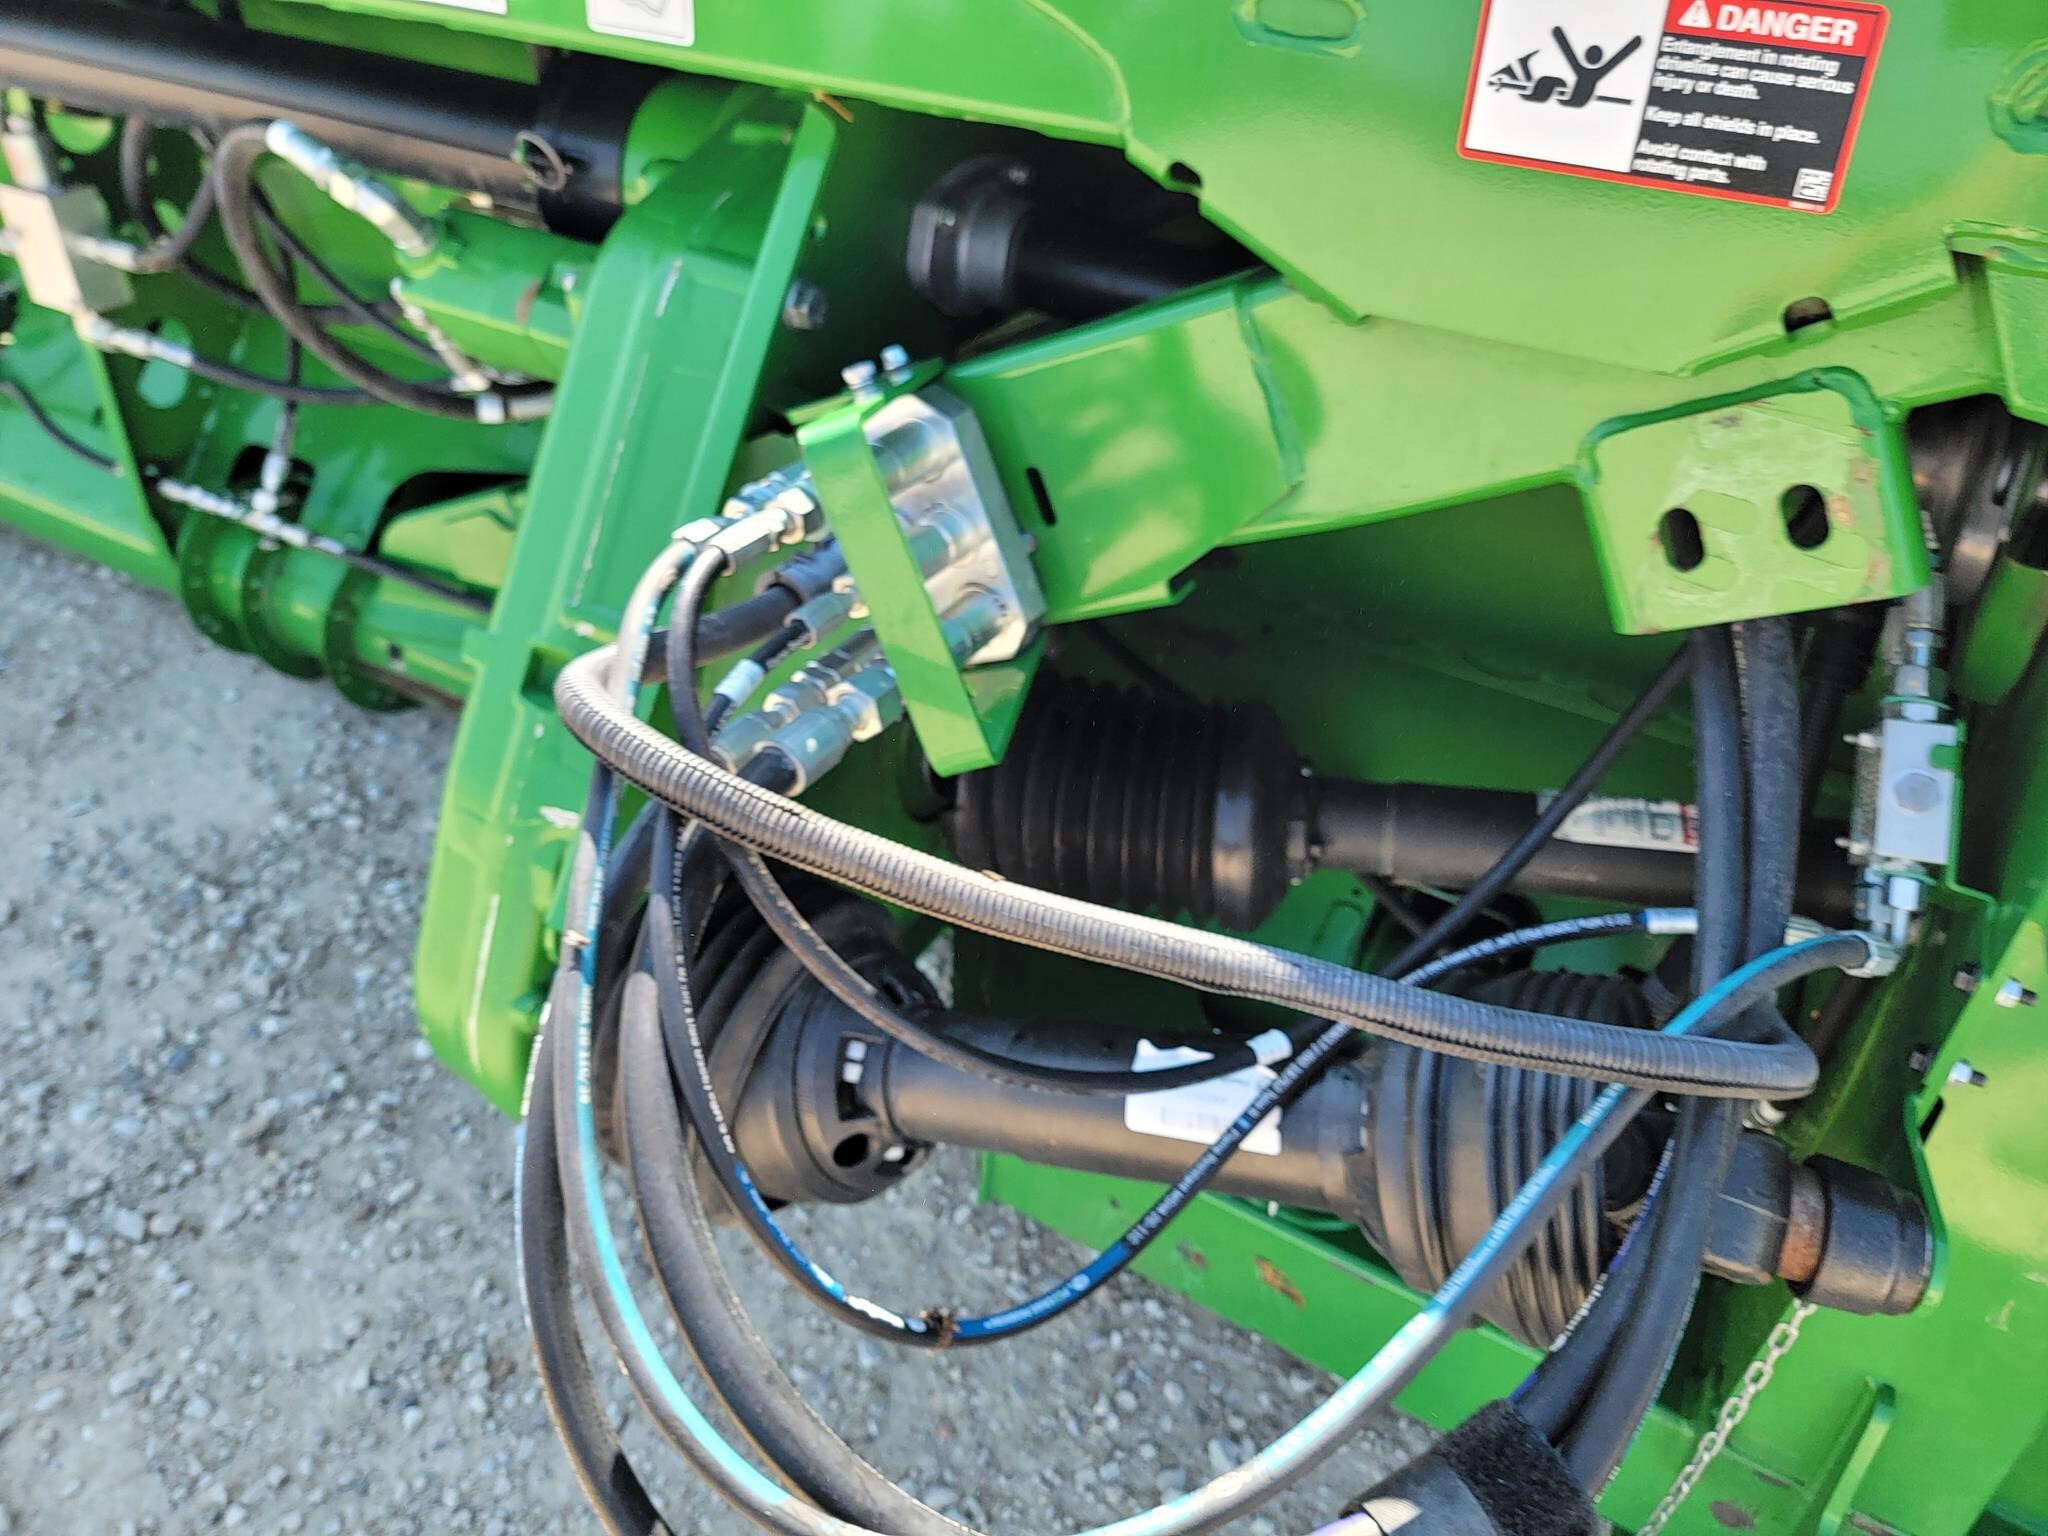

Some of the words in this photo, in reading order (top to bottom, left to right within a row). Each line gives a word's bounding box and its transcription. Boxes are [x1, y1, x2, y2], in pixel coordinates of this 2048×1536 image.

[1716, 5, 1858, 46] DANGER
[1749, 69, 1796, 85] cause
[1795, 75, 1855, 94] serious
[1643, 105, 1682, 127] Keep
[1682, 111, 1703, 127] all
